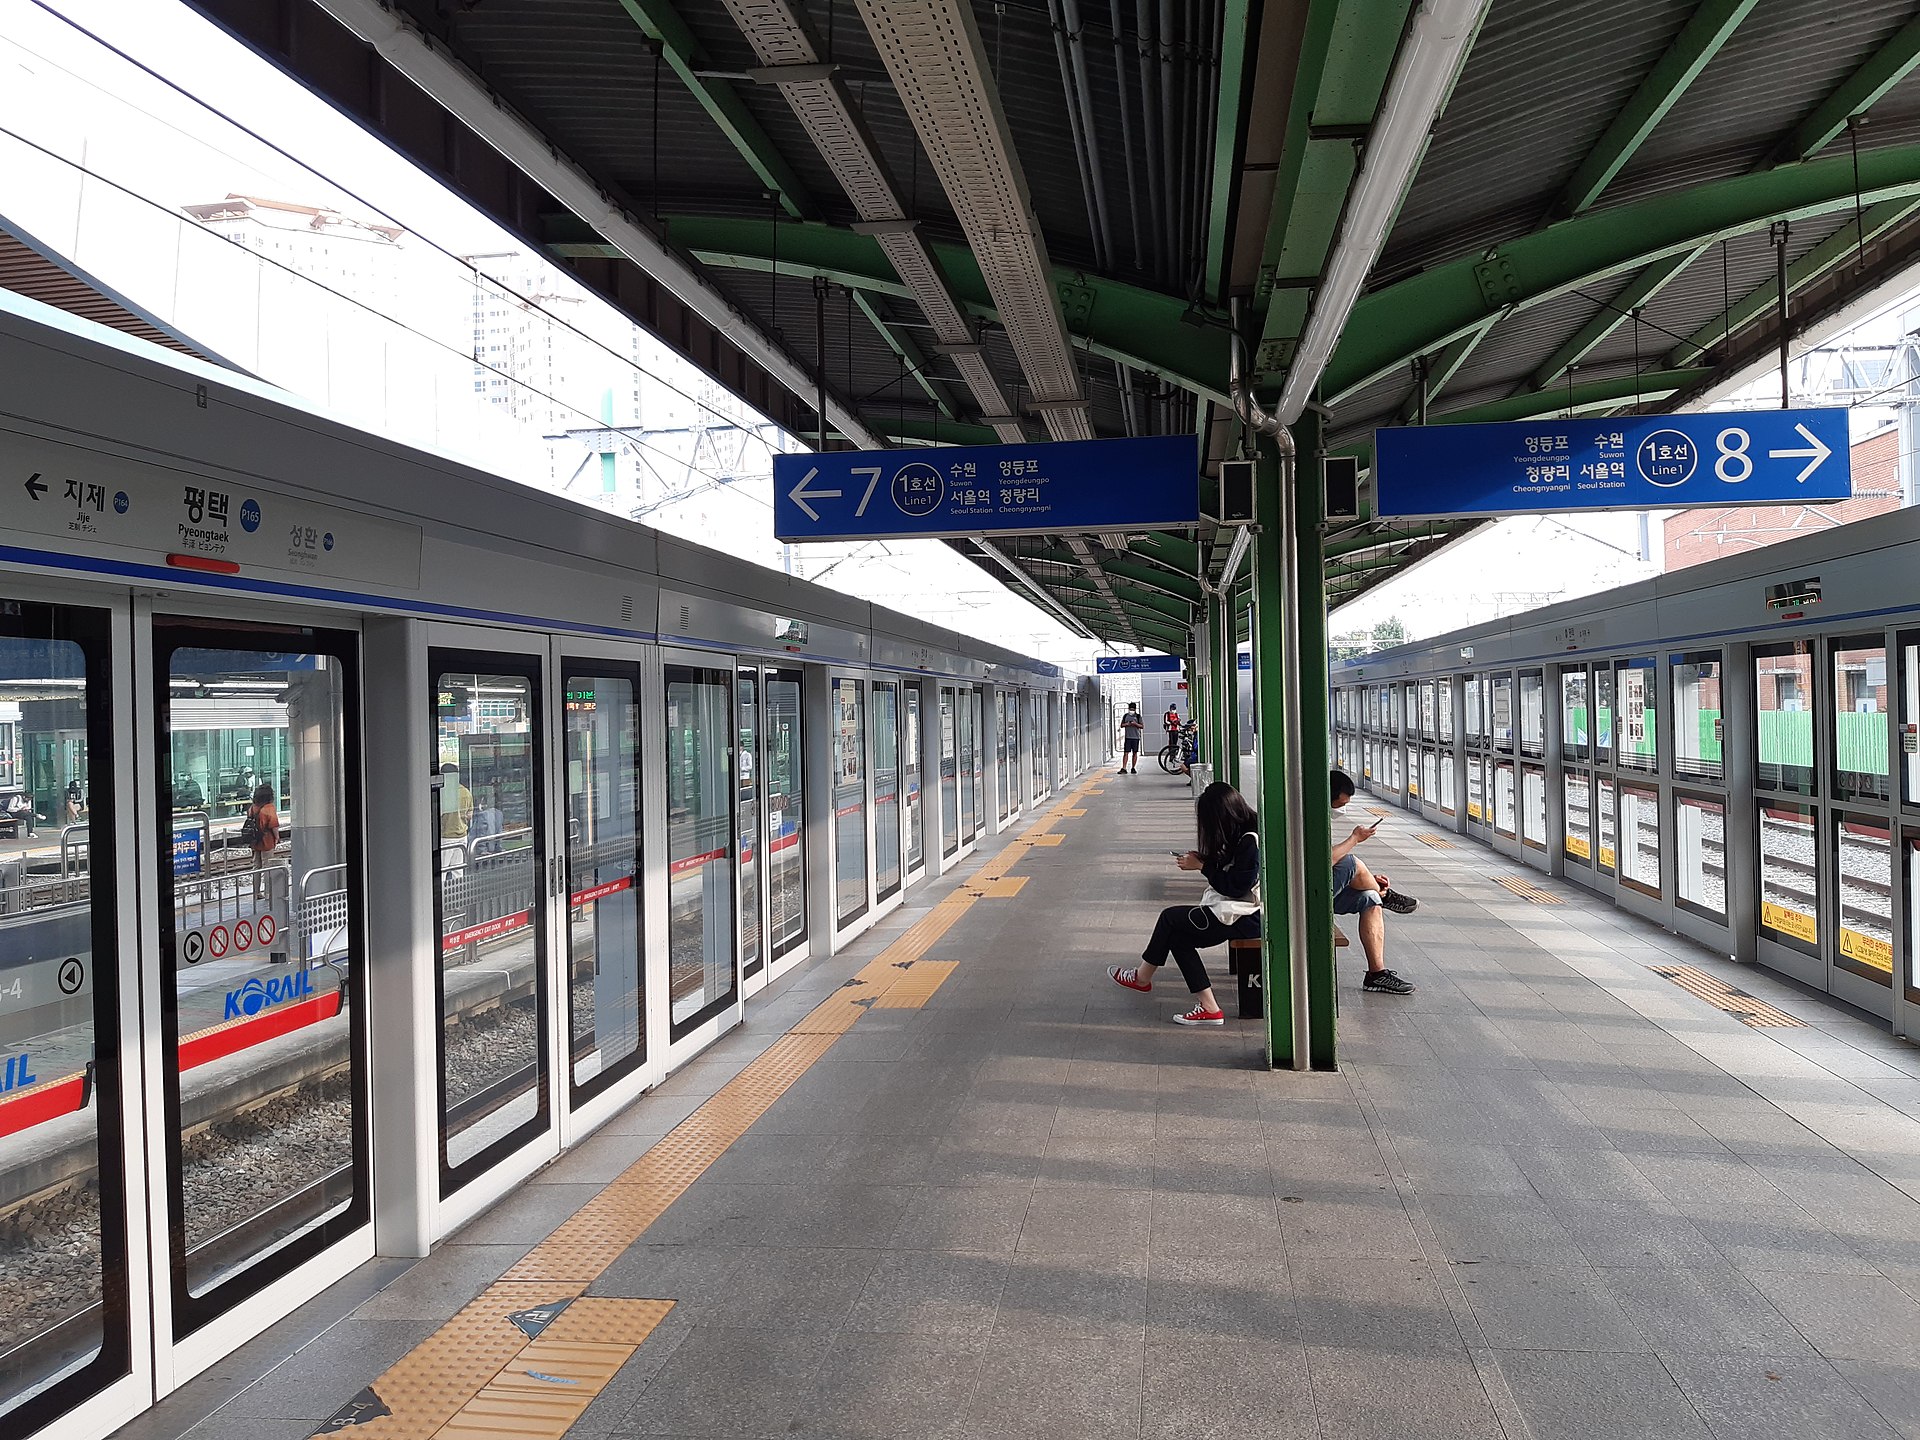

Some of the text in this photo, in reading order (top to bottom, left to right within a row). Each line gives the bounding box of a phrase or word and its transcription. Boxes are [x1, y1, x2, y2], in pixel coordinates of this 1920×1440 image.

[1524, 435, 1569, 454] 영등포
[1594, 432, 1624, 449] 수원
[1513, 454, 1570, 463] Yeongdeungpo
[1599, 451, 1625, 459] Suwon
[1645, 441, 1688, 462] 1호선
[1714, 427, 1753, 483] 8
[950, 462, 977, 478] 수원
[999, 460, 1039, 476] 영등포
[1525, 462, 1625, 483] 청량리 서울역
[899, 475, 936, 493] 1호선
[999, 477, 1050, 486] Yeongdeungpo
[1512, 483, 1571, 493] Cheongnyangni
[1577, 480, 1626, 490] Seoul Station
[63, 479, 128, 512] 지제 P164
[851, 466, 882, 517] 7
[950, 488, 1040, 505] 서울역 청량리
[183, 486, 260, 528] 평택 P165
[969, 506, 993, 514] Station
[999, 504, 1051, 514] Cheongnyangni
[77, 512, 90, 524] Jije
[178, 523, 230, 543] Pyeongtaek
[289, 524, 318, 549] 성환
[1111, 660, 1118, 670] 7
[0, 977, 23, 1000] -4
[224, 968, 314, 1021] KORAIL
[331, 1402, 374, 1426] 8-4
